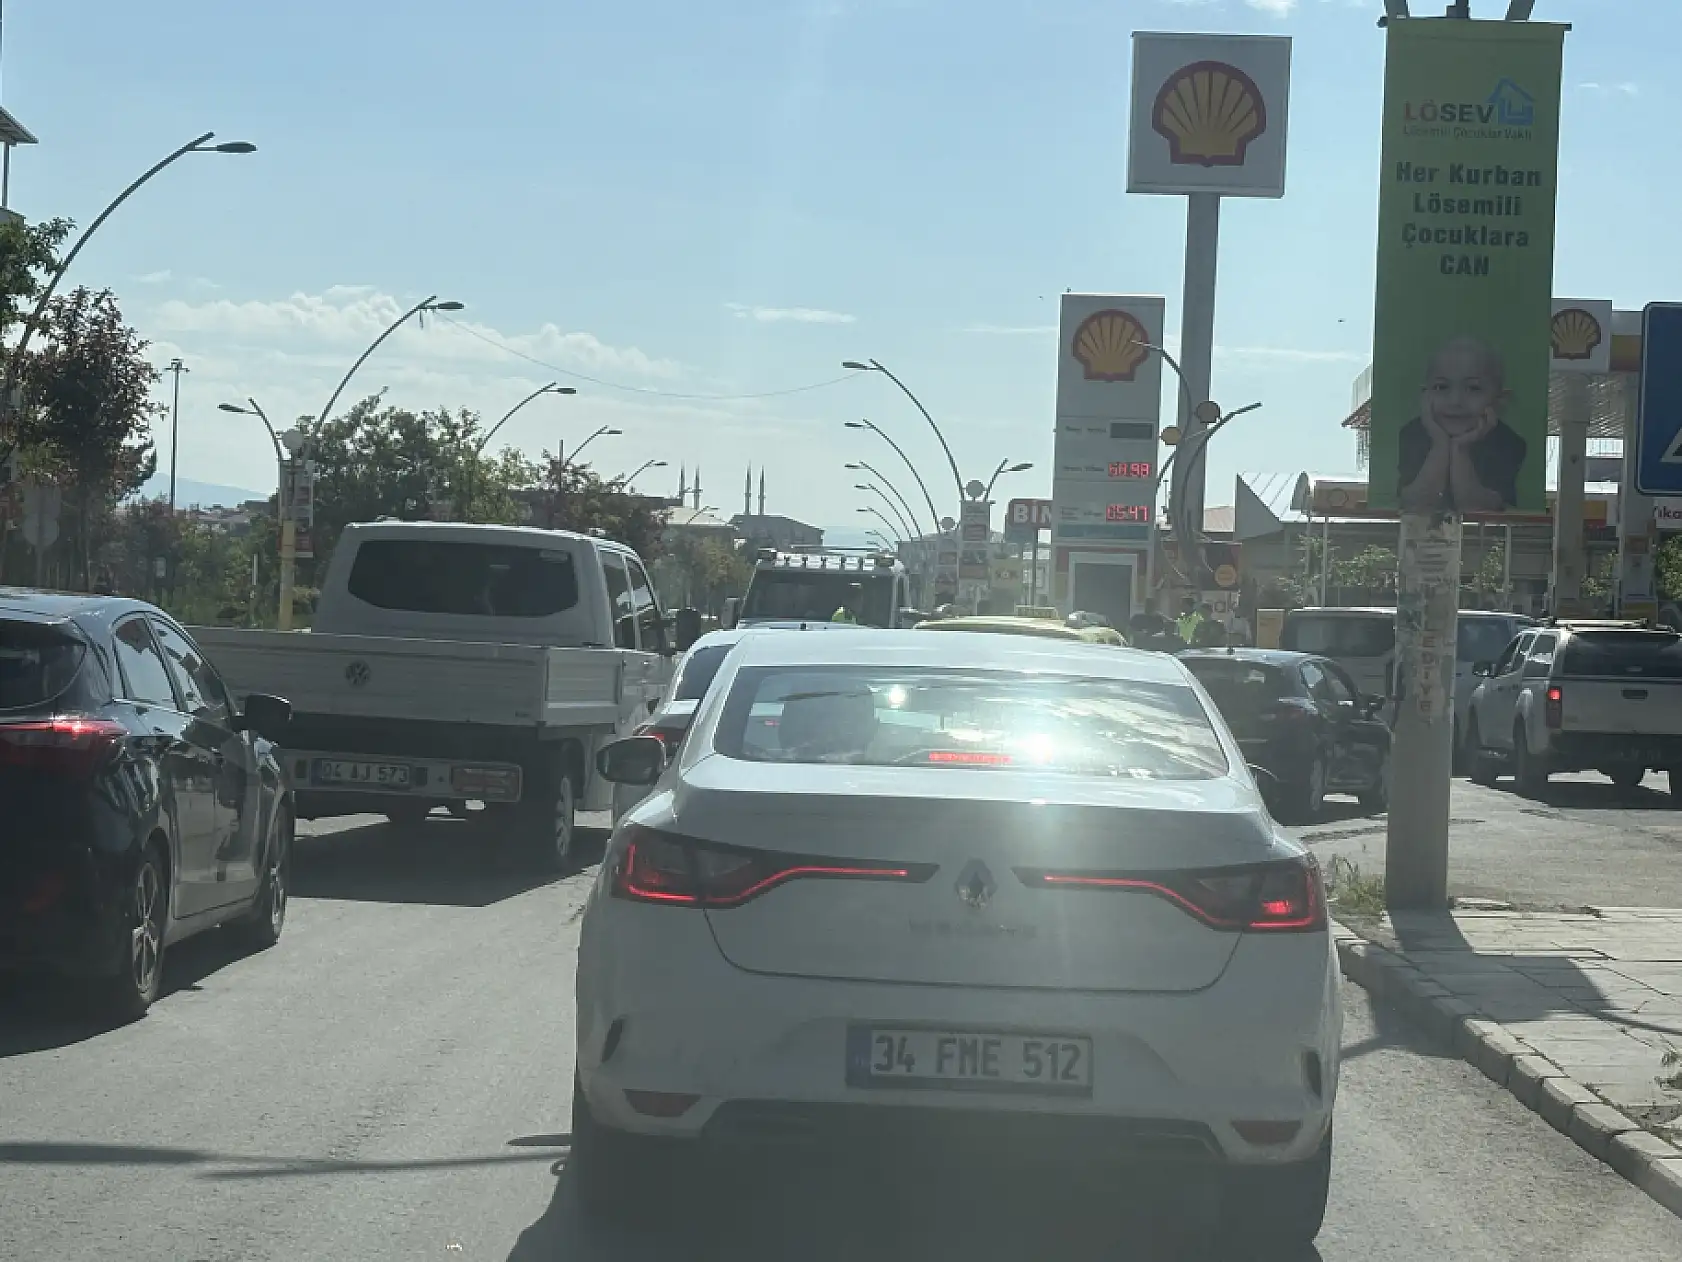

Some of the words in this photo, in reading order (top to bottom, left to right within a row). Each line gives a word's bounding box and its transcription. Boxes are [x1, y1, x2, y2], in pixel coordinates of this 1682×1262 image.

[1403, 98, 1495, 123] LÖSEV
[1396, 161, 1440, 183] Her
[1449, 162, 1541, 187] Kurban
[1413, 192, 1522, 216] Lösemili
[1401, 222, 1529, 249] Çocuklara
[1440, 254, 1490, 276] CAN
[873, 1034, 916, 1074] 34
[936, 1036, 1001, 1077] FME
[1022, 1040, 1081, 1081] 512
